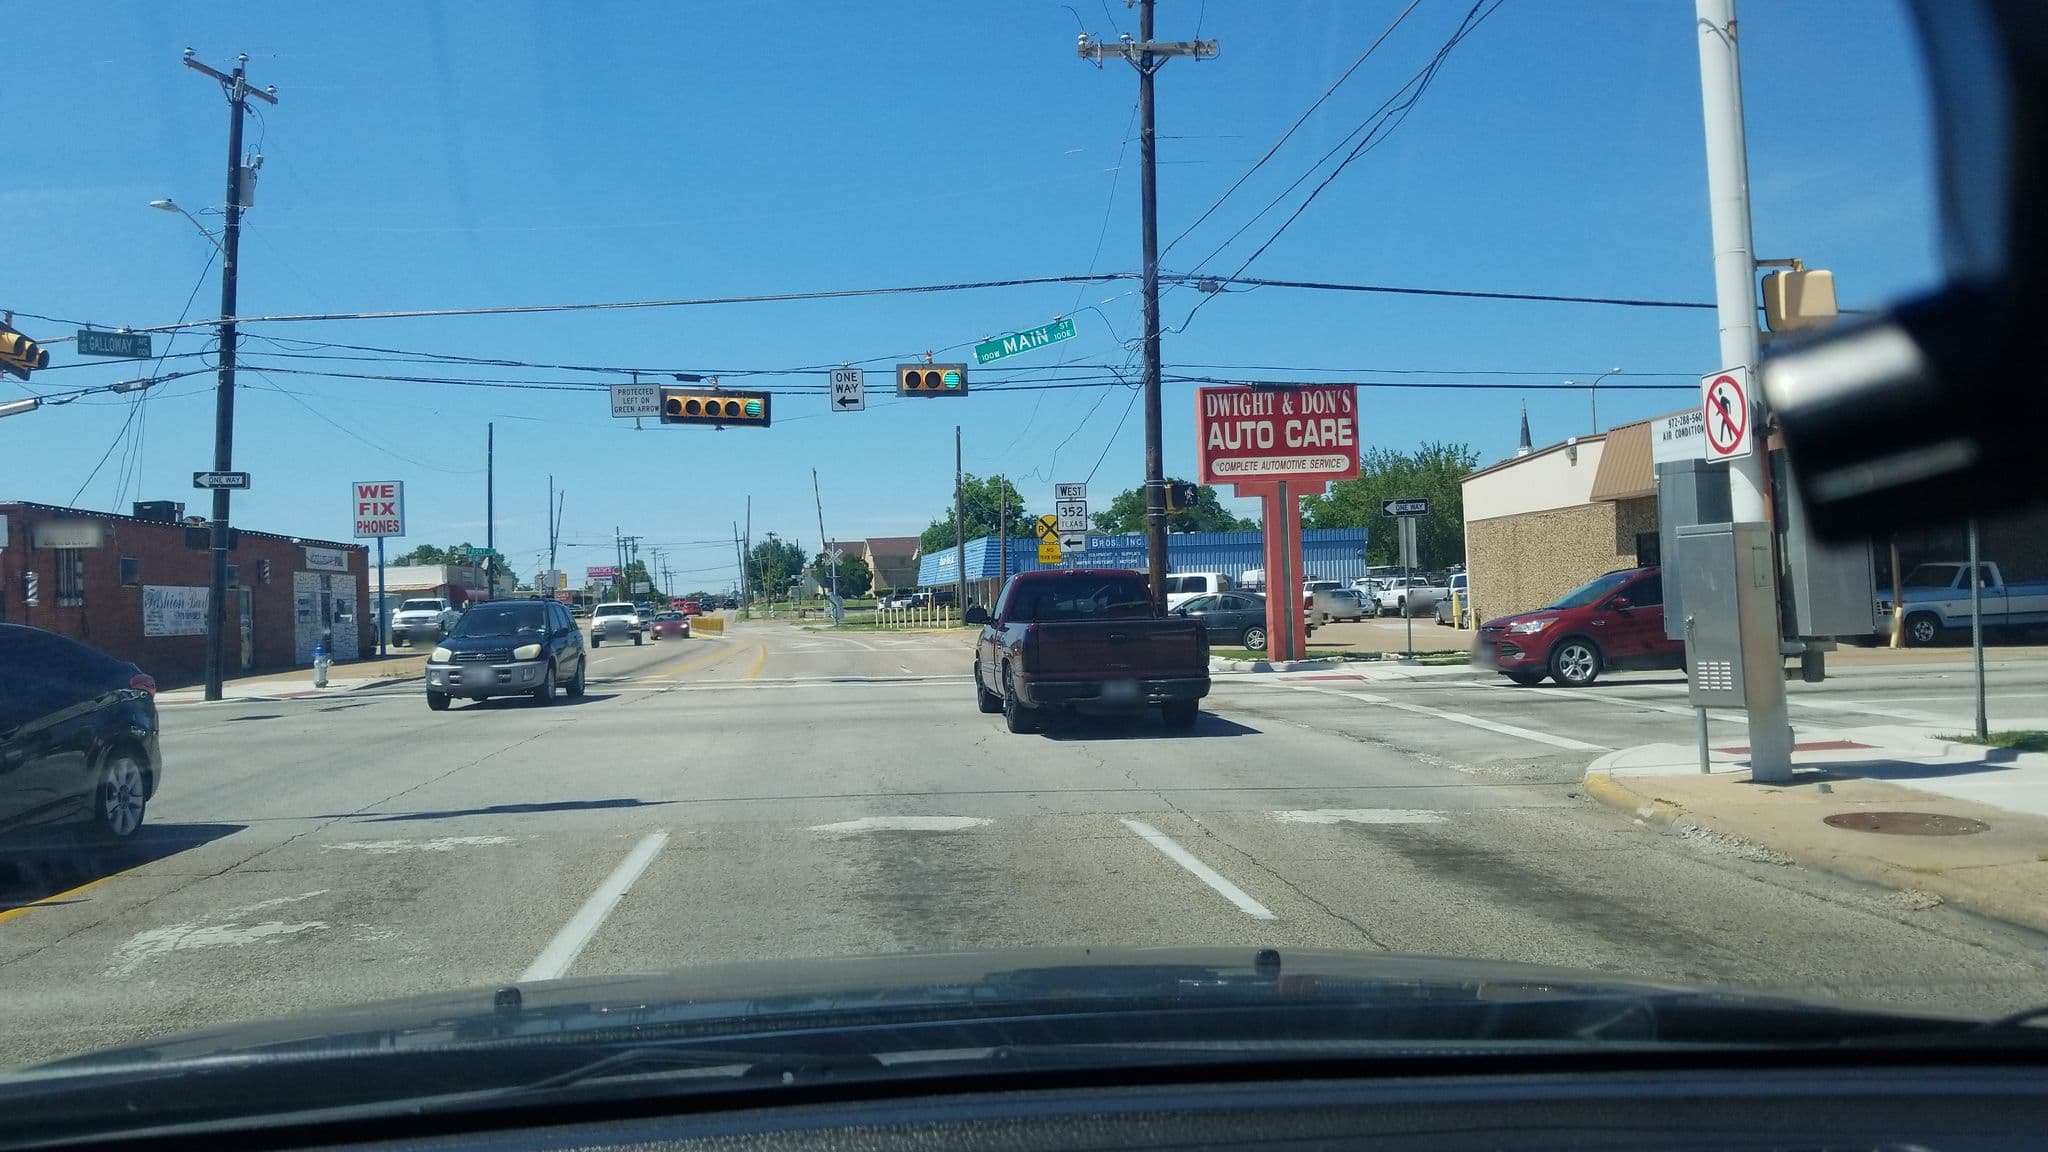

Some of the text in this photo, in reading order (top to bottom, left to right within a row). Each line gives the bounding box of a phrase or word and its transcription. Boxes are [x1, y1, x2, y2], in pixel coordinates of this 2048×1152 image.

[1003, 321, 1069, 354] MAIN ST
[1054, 329, 1071, 341] 100E
[89, 336, 132, 353] GALLOWAY
[982, 350, 1000, 361] 100W
[836, 372, 858, 382] ONE
[617, 388, 654, 396] PROTECTED
[836, 384, 858, 393] WAY
[1207, 389, 1351, 417] DWIGHT & DON'S
[1668, 412, 1702, 429] 972-288-560
[1208, 418, 1353, 450] AUTO CARE
[1663, 431, 1672, 441] AIR
[1261, 460, 1306, 471] AUTOMOTIVE
[209, 476, 241, 484] ONE WAY
[358, 484, 394, 498] WE
[1060, 486, 1082, 496] WEST
[359, 502, 395, 516] FIX
[1061, 506, 1083, 517] 352
[357, 520, 400, 533] PHONES
[1061, 520, 1083, 528] TEXAS
[145, 591, 184, 609] Fashion
